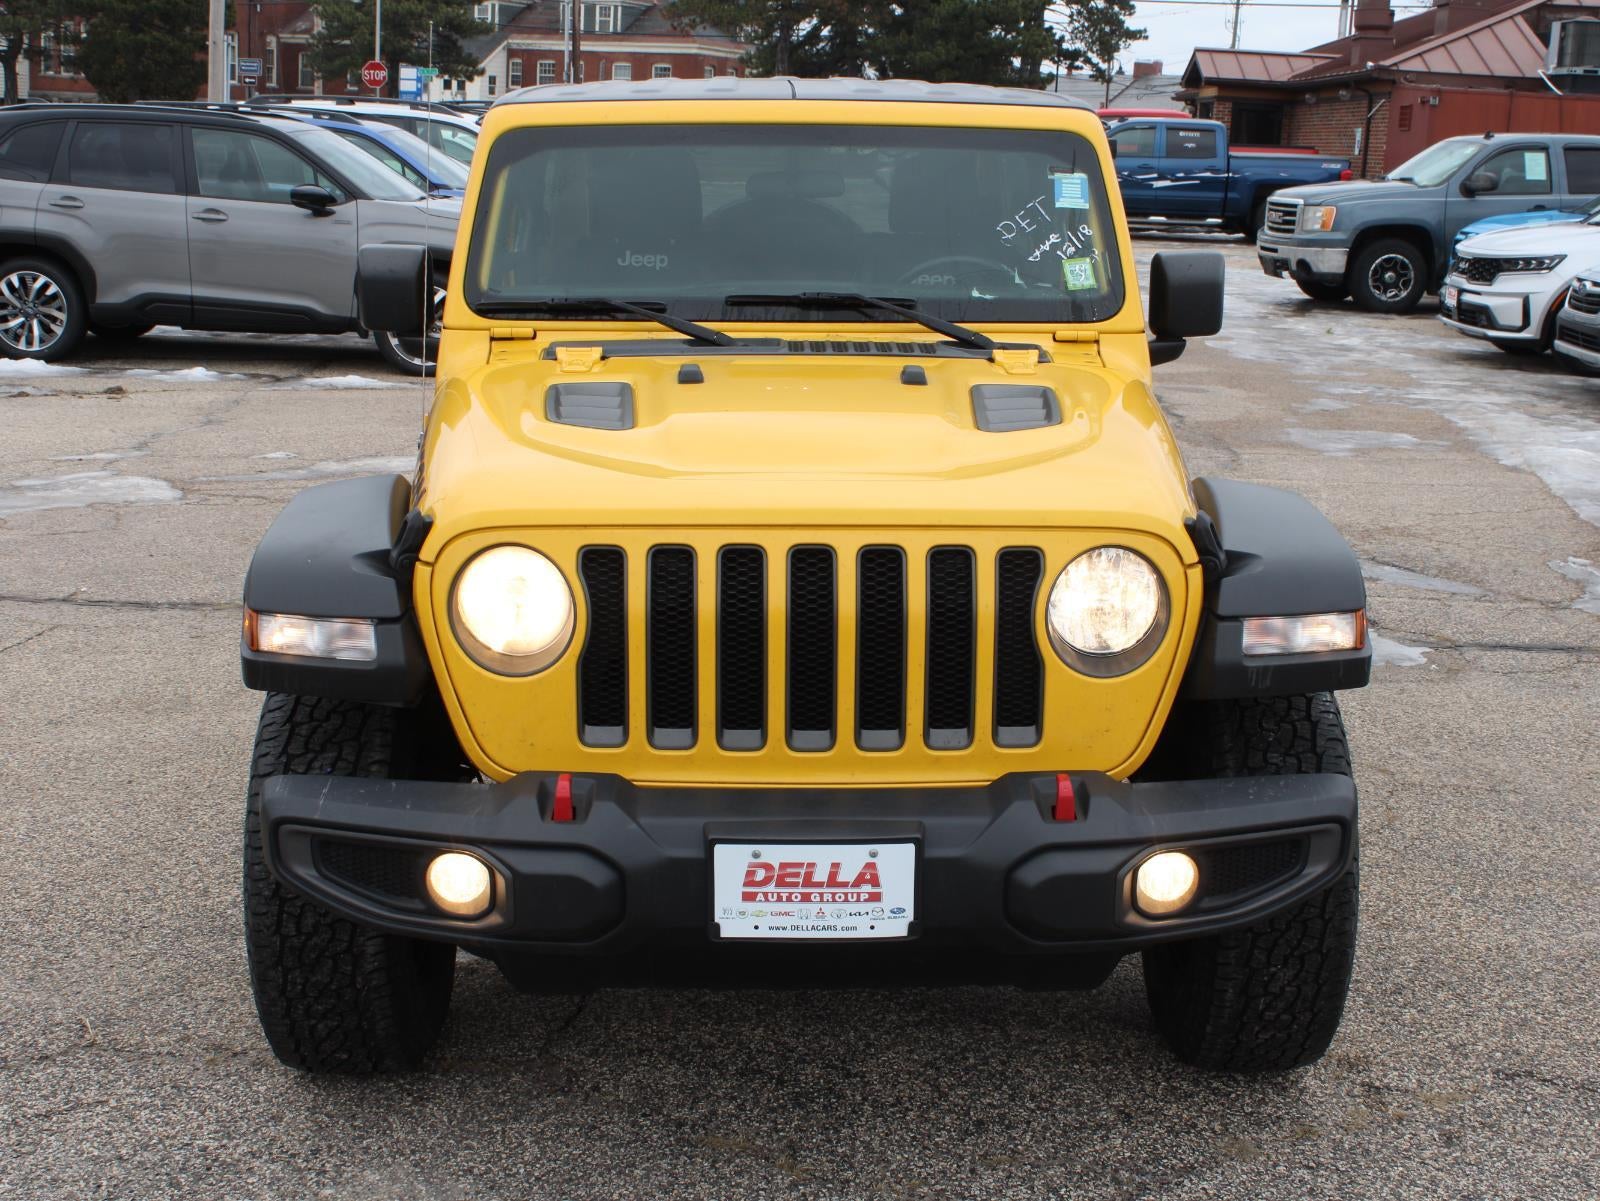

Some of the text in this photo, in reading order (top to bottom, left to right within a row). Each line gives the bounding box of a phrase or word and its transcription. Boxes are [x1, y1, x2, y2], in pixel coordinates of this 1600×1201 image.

[364, 70, 387, 80] STOP
[996, 195, 1051, 240] DET
[617, 250, 668, 270] Jeep
[911, 274, 957, 286] eep
[742, 861, 883, 889] DELLA
[756, 892, 869, 902] AUTO GROUP
[768, 924, 858, 932] www.DELLACARS.com
